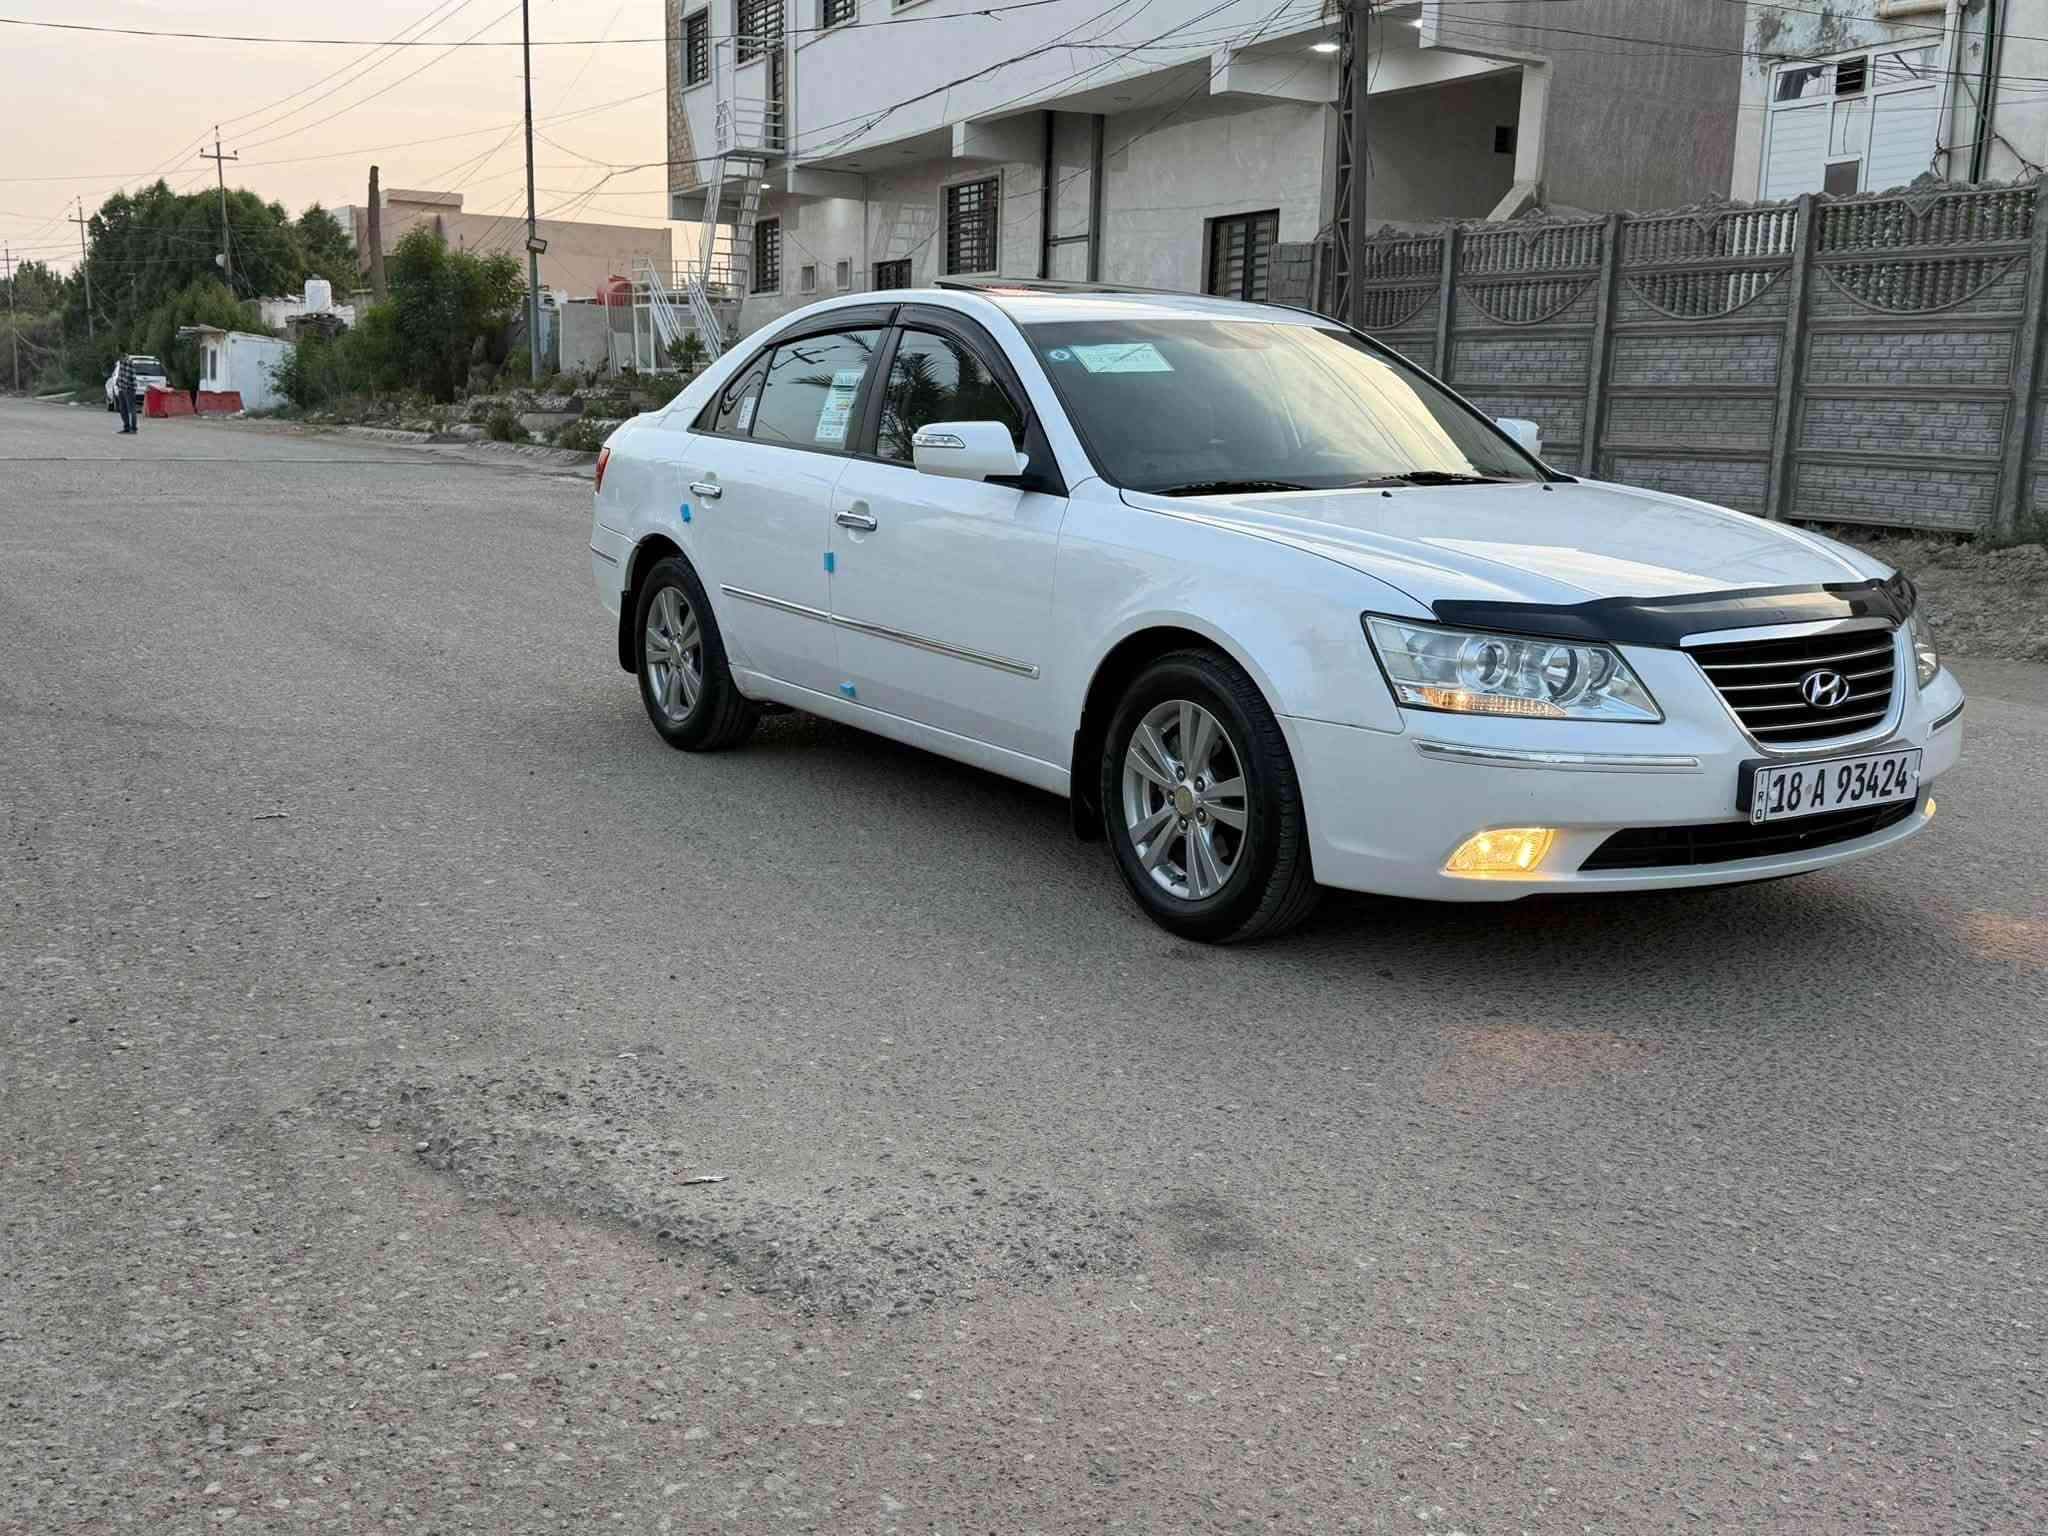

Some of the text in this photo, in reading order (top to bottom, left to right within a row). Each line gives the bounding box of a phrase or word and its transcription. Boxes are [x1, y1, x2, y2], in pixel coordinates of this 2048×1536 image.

[1769, 757, 1908, 813] 18 A 93424
